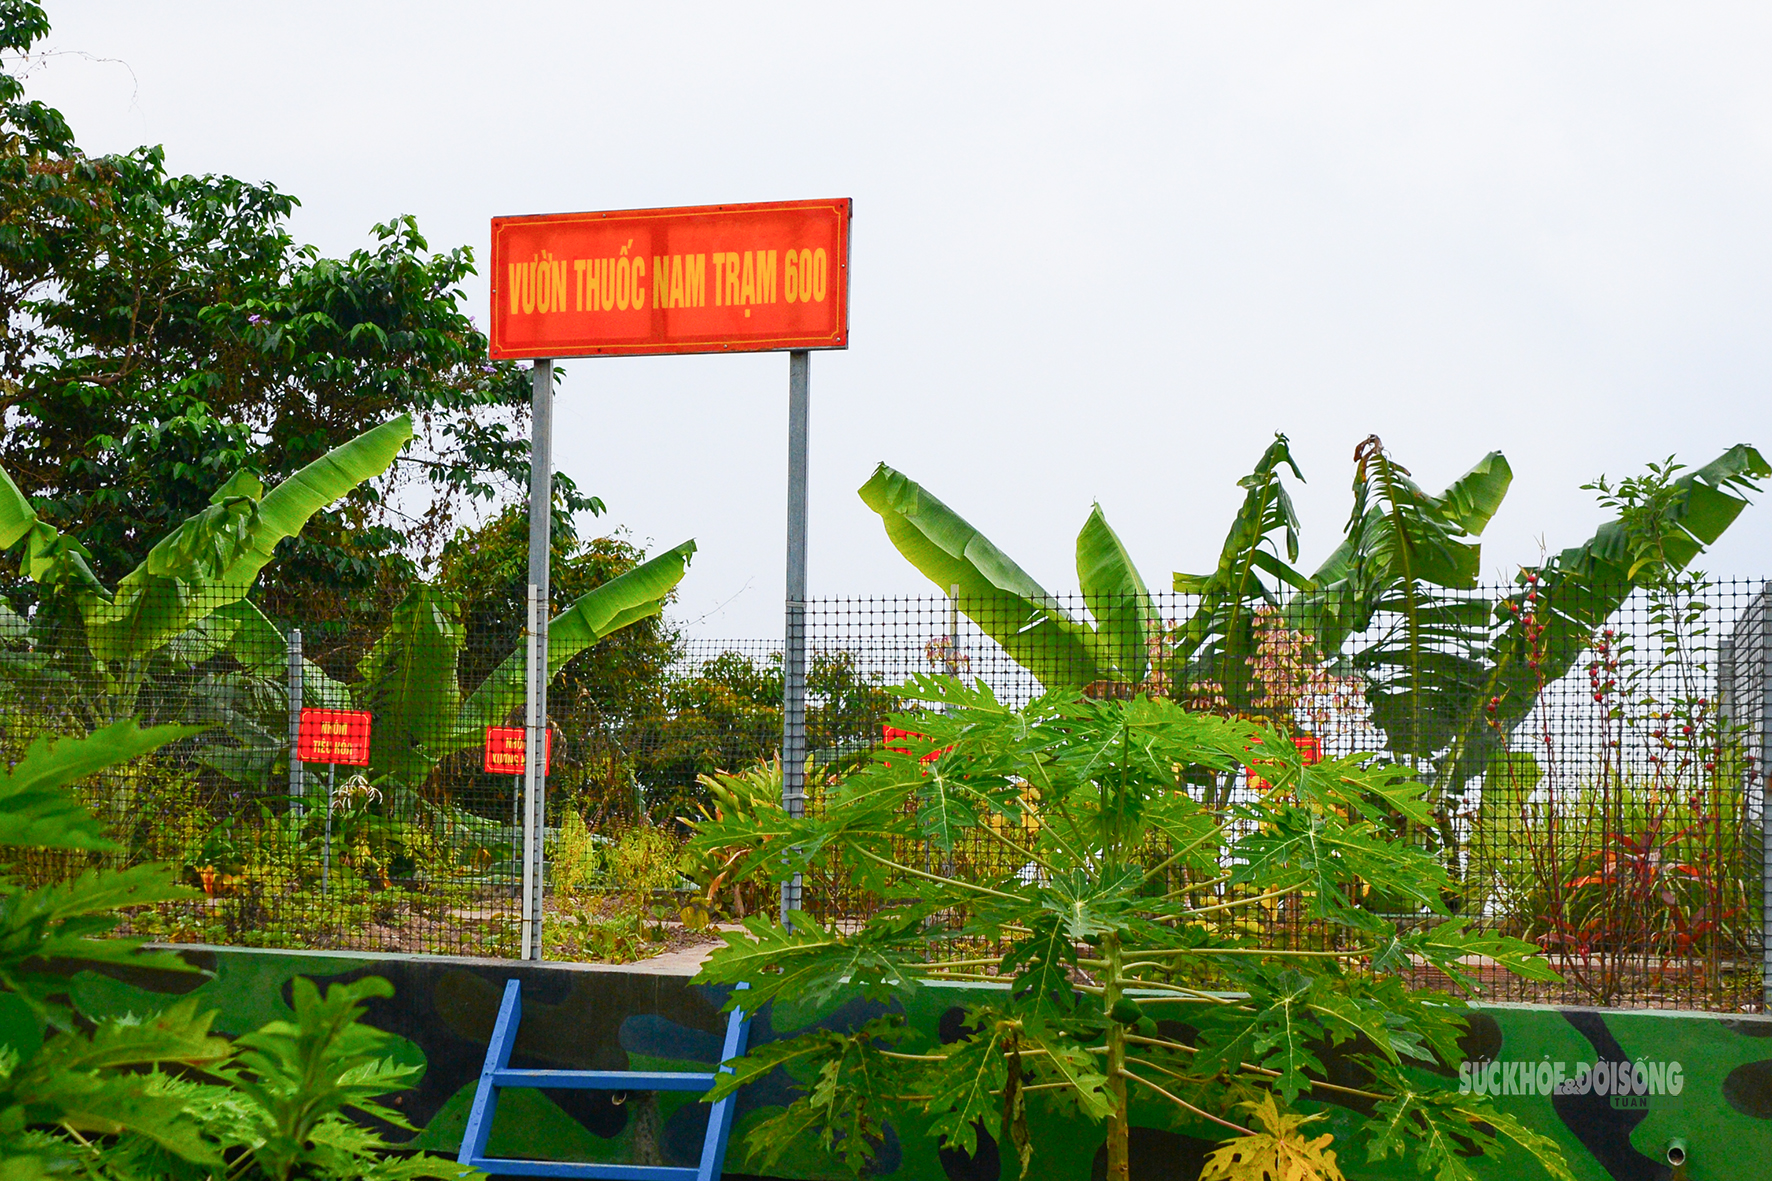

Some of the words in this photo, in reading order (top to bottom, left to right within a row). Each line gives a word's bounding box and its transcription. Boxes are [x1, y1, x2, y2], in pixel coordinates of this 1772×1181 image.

[509, 249, 567, 315] VƯỜN
[574, 239, 645, 312] THUỐC
[653, 253, 706, 309] NAM
[712, 249, 778, 318] TRẠM
[784, 247, 827, 304] 600
